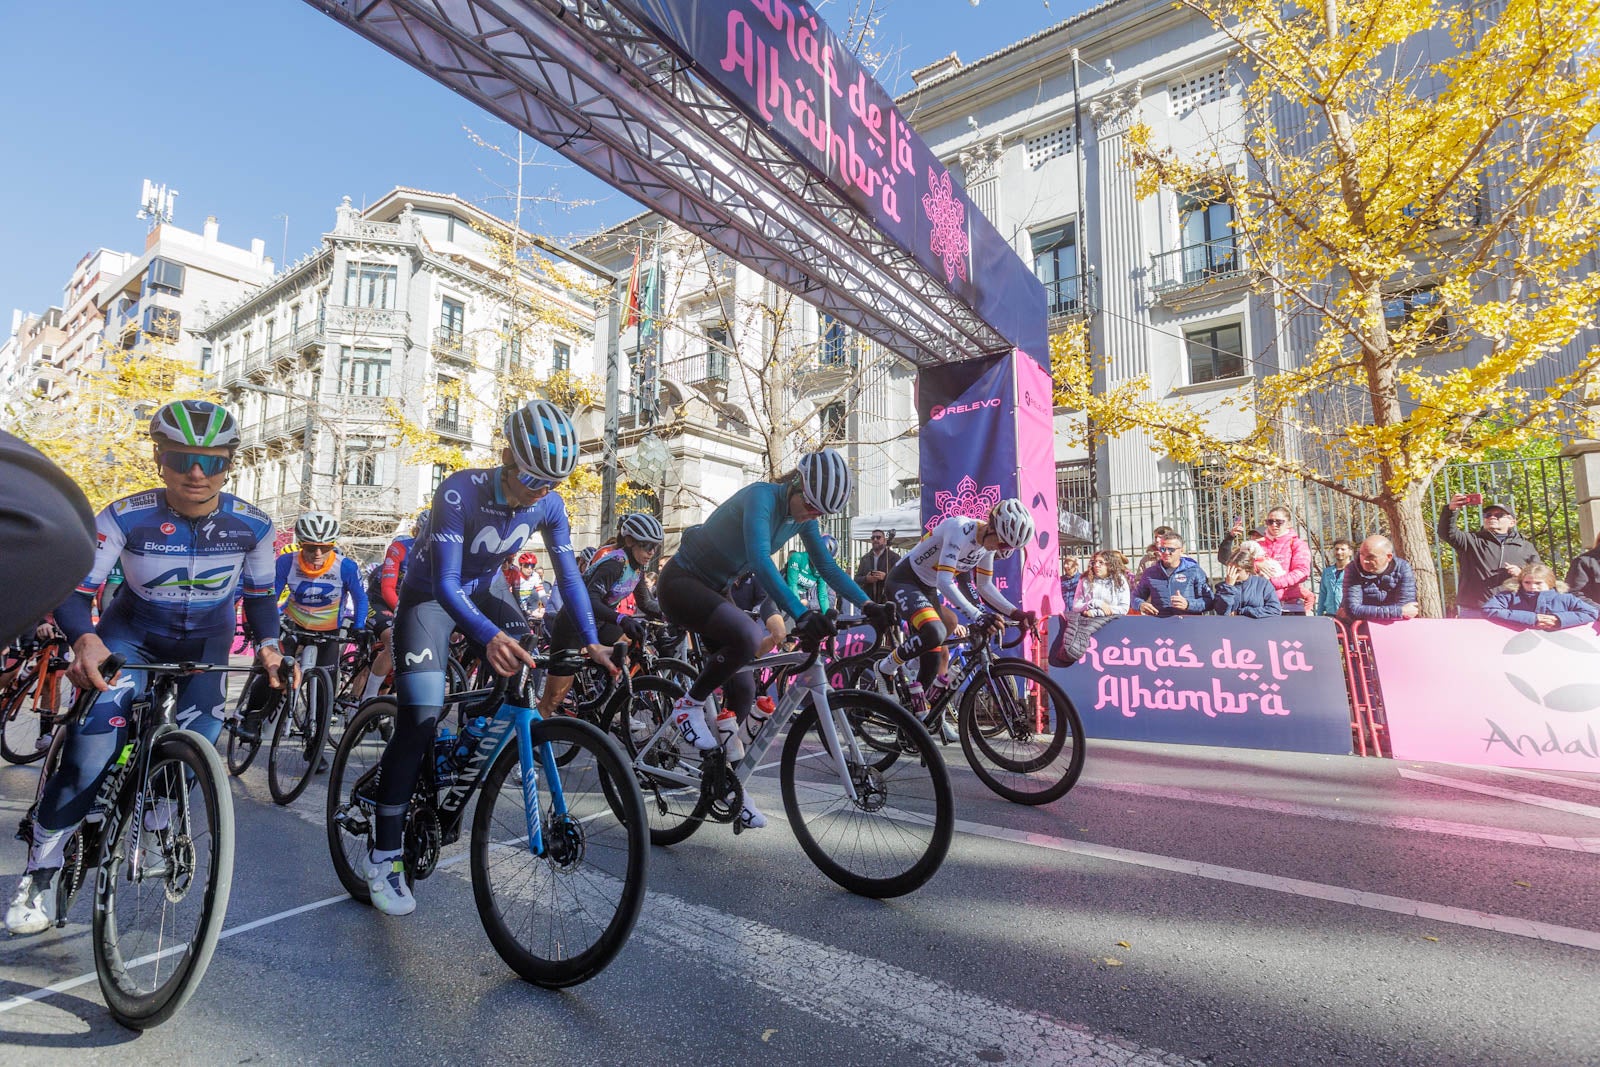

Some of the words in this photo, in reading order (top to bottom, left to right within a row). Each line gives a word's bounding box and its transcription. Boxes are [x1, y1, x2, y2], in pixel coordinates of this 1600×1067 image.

[719, 9, 902, 224] Alhämbrä
[848, 71, 887, 158] de
[889, 109, 916, 176] lä
[946, 398, 1002, 415] RELEVO
[144, 541, 188, 553] Ekopak
[914, 544, 939, 566] CADEX
[142, 564, 235, 591] AG
[995, 577, 1009, 592] lä
[843, 633, 866, 658] lä
[1078, 636, 1205, 672] Reinäs
[1211, 639, 1264, 681] de
[1267, 639, 1314, 681] lä
[1094, 674, 1291, 718] Alhämbrä
[1480, 717, 1600, 759] Andal
[441, 719, 512, 812] CANYON
[525, 767, 541, 838] CANYON
